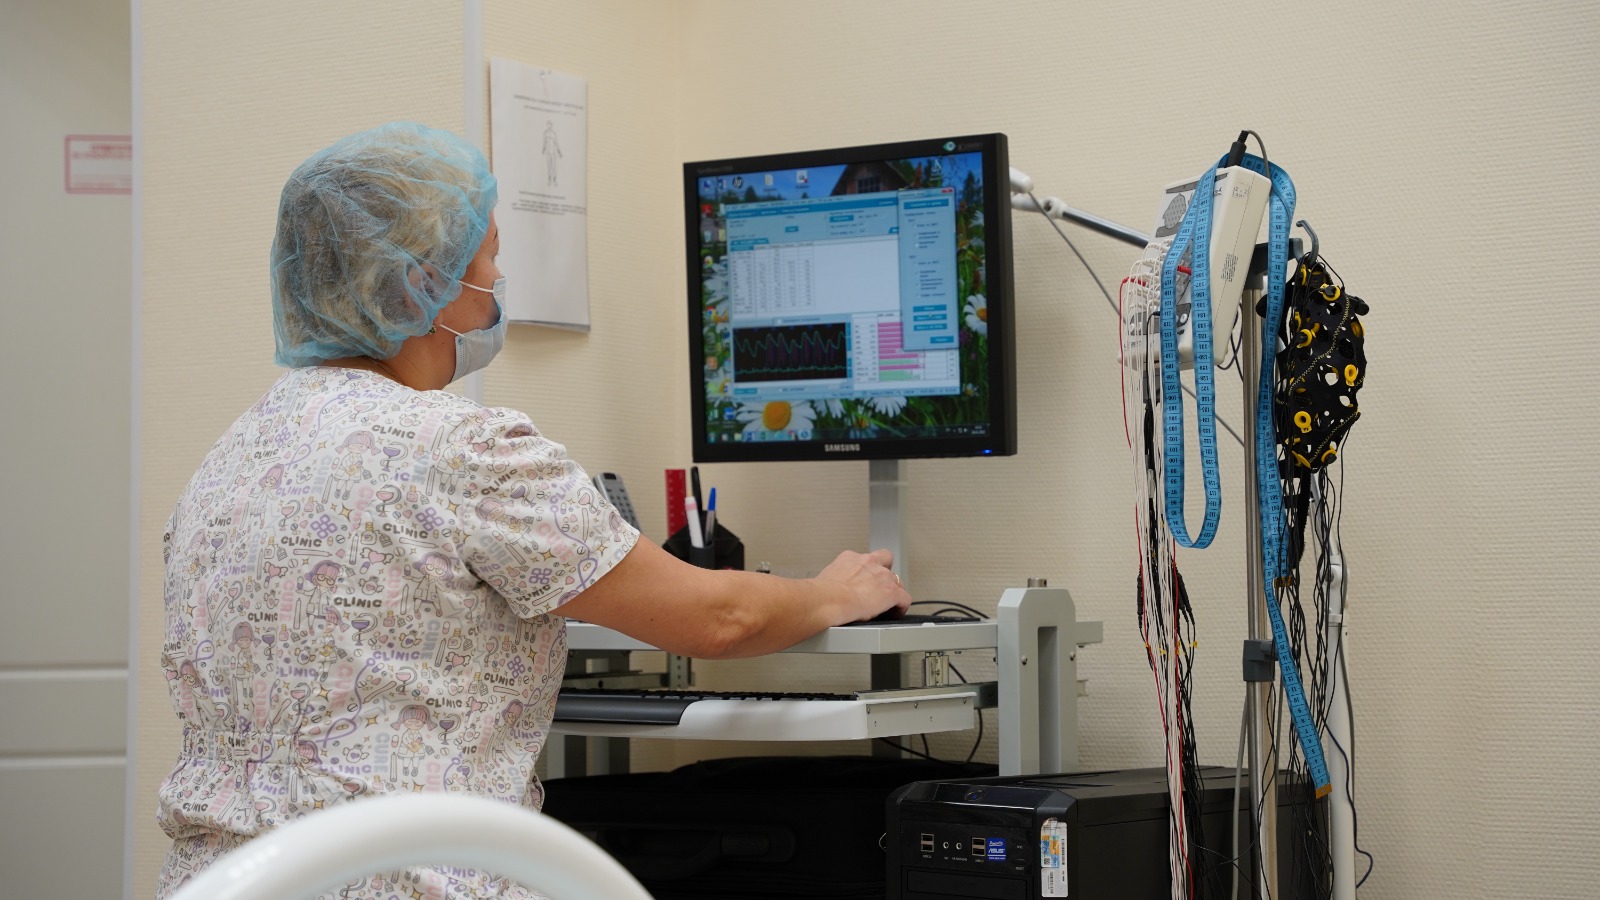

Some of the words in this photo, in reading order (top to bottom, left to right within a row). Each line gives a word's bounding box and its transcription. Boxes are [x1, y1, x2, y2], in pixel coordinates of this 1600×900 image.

[371, 424, 416, 439] CLINIC
[824, 443, 860, 452] SAMSUNG
[254, 449, 279, 459] CLINIC
[480, 468, 517, 496] CLINIC
[275, 486, 311, 497] CLINIC
[383, 523, 429, 539] CLINIC
[281, 536, 323, 548] CLINIC
[537, 522, 574, 561] CURE
[479, 535, 513, 566] CURE
[220, 565, 247, 576] CLINIC
[333, 597, 383, 608] CLINIC
[248, 612, 278, 622] CLINIC
[420, 620, 441, 660] CURE
[373, 650, 421, 662] CLINIC
[484, 673, 515, 686] CLINIC
[426, 697, 463, 708] CLINIC
[374, 733, 390, 774] CURE
[182, 802, 208, 812] CLINIC
